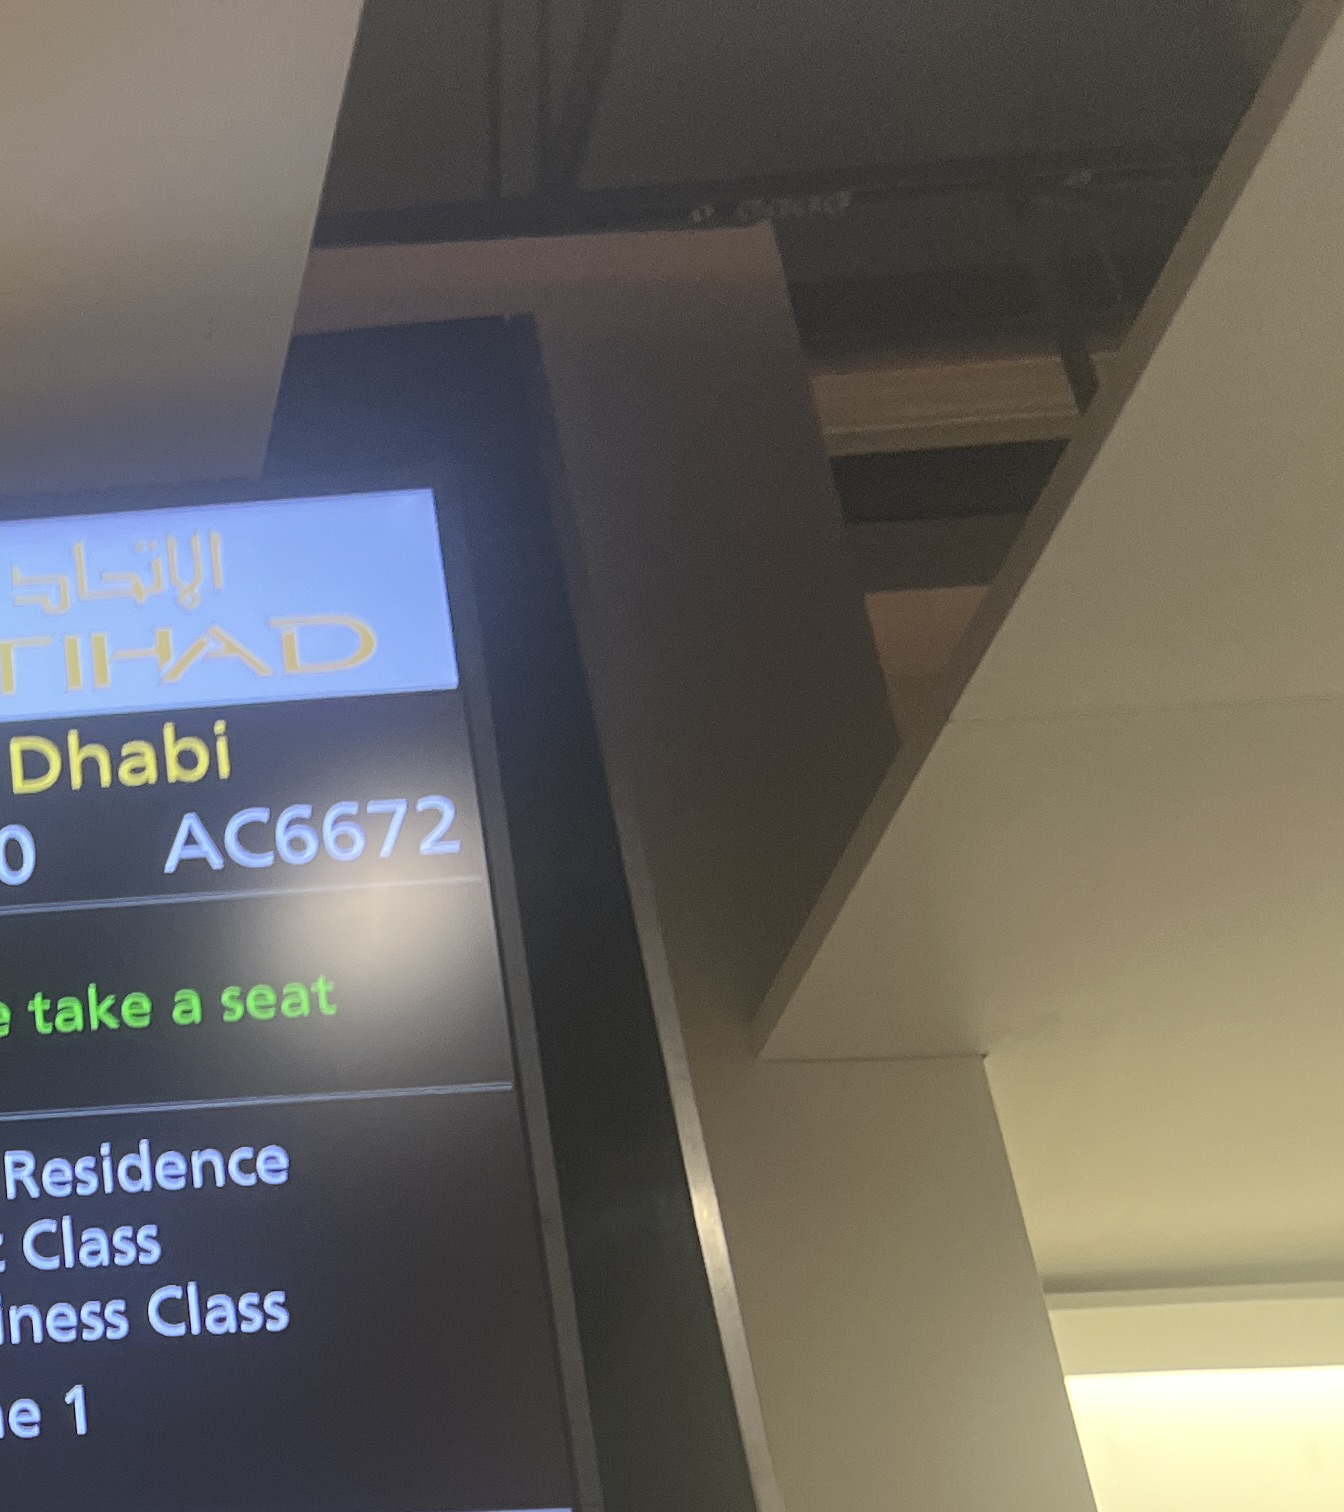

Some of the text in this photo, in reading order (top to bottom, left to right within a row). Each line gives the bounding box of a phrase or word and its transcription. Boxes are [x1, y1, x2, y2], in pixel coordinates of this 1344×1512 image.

[9, 719, 232, 796] Dhabi
[163, 795, 462, 875] AC6672
[26, 981, 152, 1035] take
[170, 987, 204, 1026] a
[220, 975, 338, 1023] seat
[3, 1137, 291, 1201] Residence
[21, 1214, 163, 1271] Class
[146, 1280, 291, 1338] Class
[63, 1383, 89, 1436] 1
